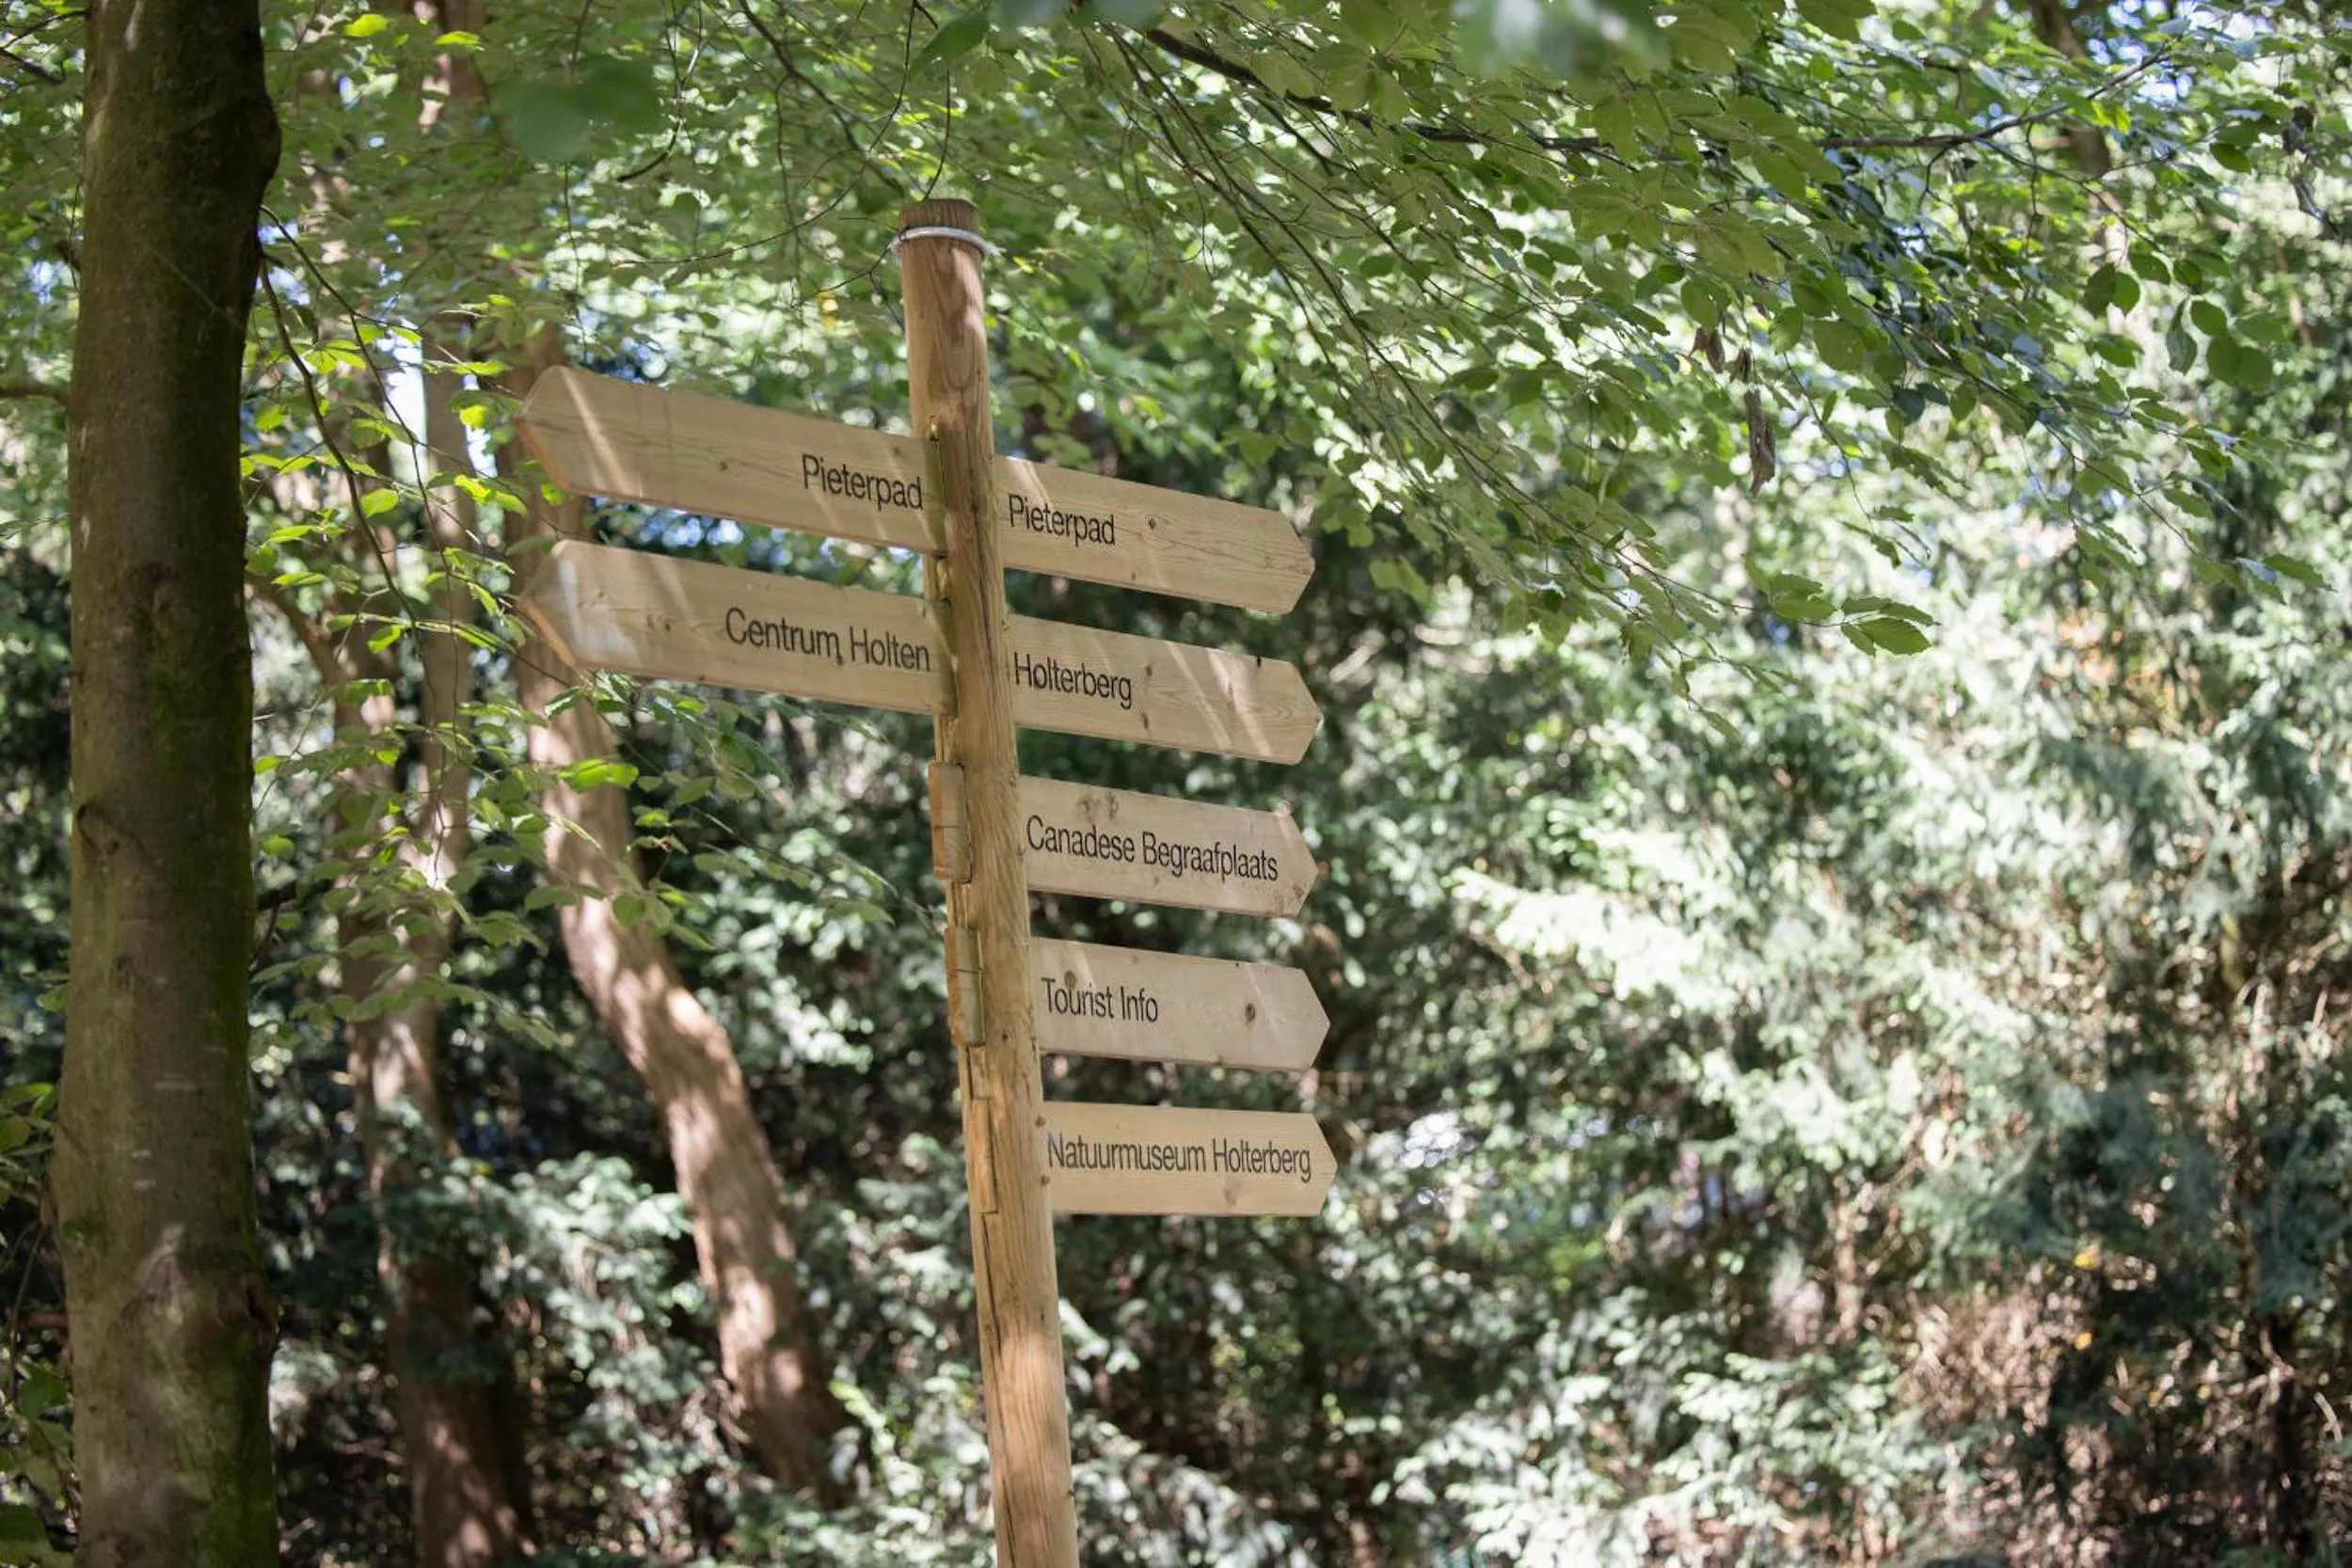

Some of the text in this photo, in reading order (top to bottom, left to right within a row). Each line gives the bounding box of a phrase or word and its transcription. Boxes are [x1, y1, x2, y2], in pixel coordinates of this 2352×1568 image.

[802, 453, 923, 513] Pieterpad
[1009, 494, 1116, 547] Pieterpad
[725, 606, 930, 673] Centrum Holten
[1014, 652, 1134, 710] Holterberg
[1026, 815, 1279, 882] Canadese Begraafplaats
[1041, 976, 1159, 1023] Tourist Info
[1047, 1133, 1312, 1183] Natuurmuseum Holterberg
